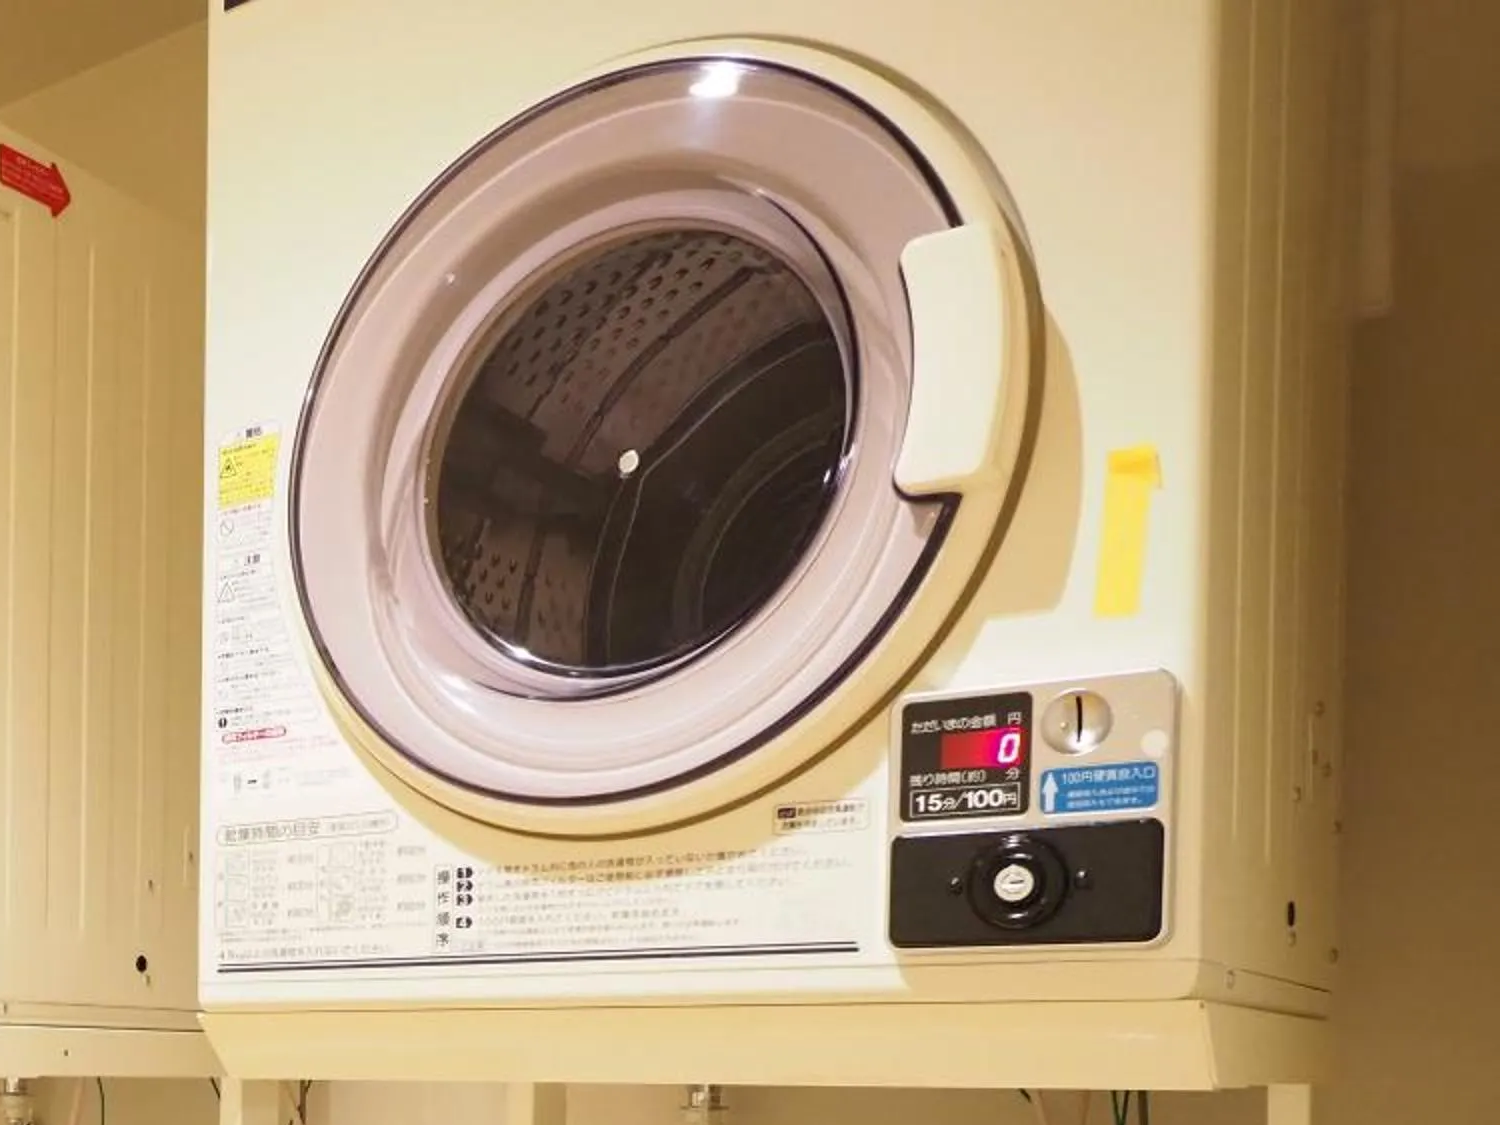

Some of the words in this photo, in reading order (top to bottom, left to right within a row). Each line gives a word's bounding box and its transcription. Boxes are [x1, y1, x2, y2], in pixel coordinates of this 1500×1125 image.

[1007, 711, 1022, 725] 円
[997, 733, 1021, 763] 0
[1005, 767, 1020, 781] 分
